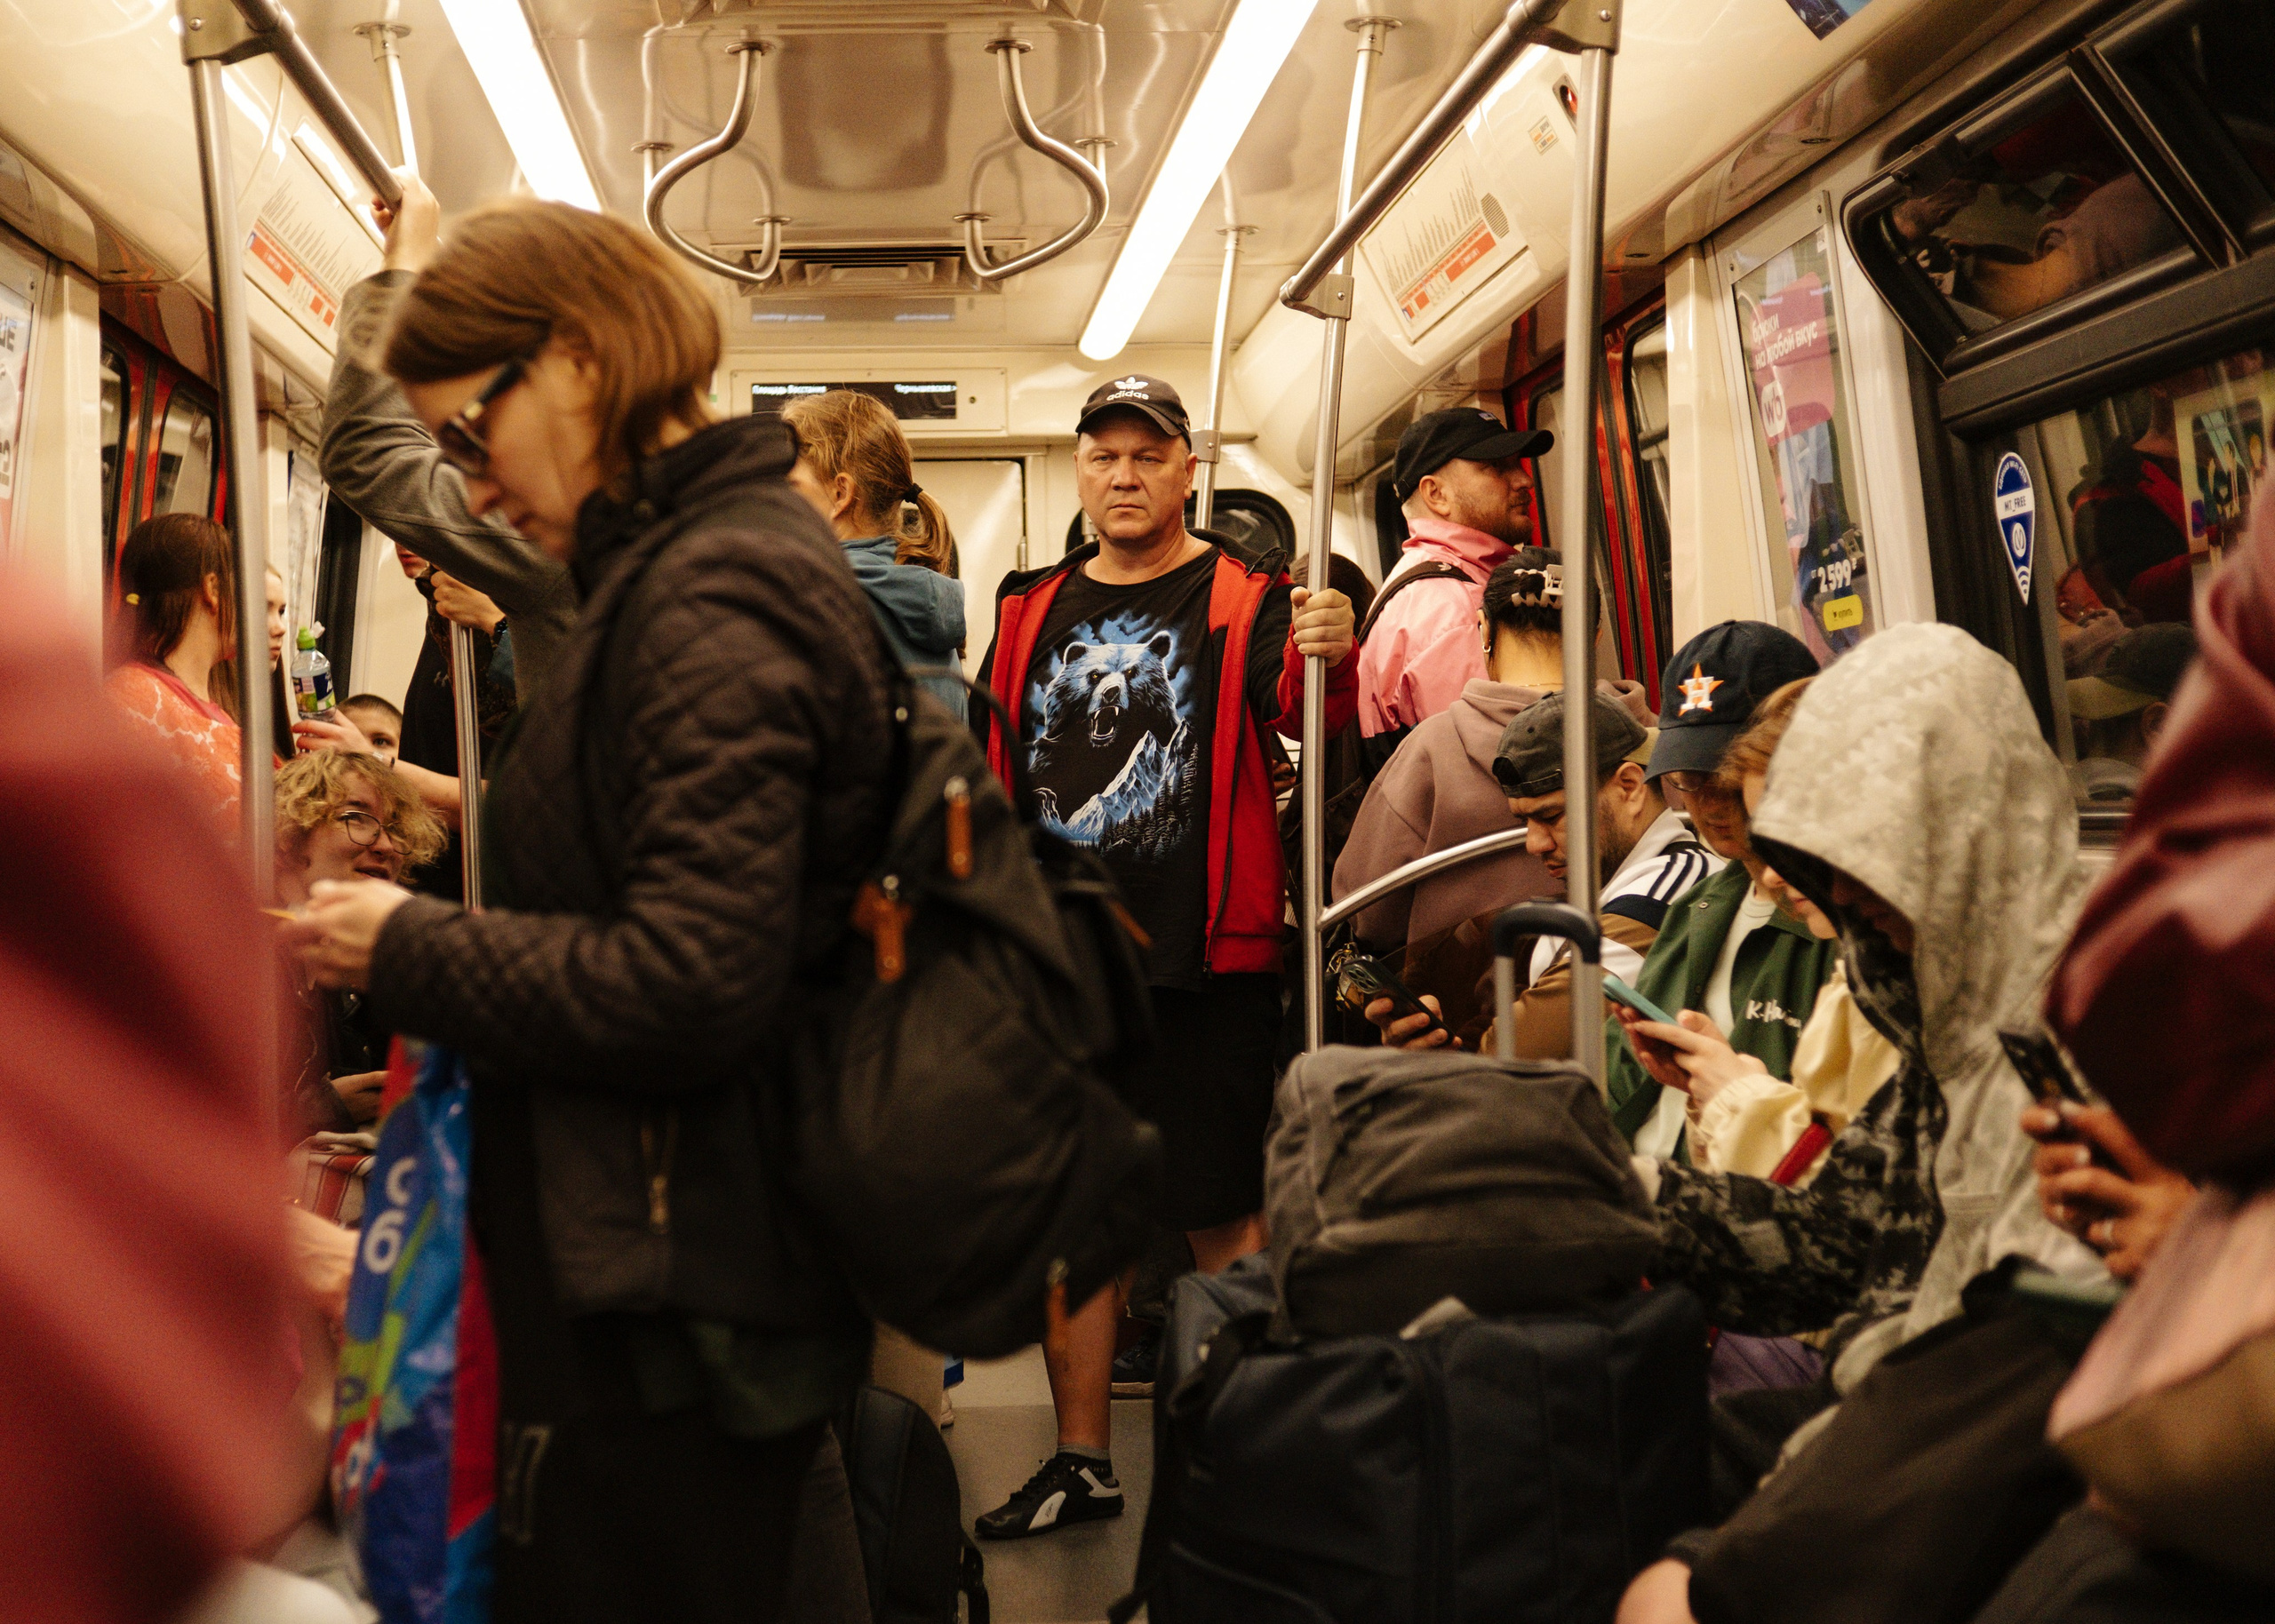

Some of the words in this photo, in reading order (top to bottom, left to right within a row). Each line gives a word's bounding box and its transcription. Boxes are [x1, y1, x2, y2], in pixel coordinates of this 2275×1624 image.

[1752, 313, 1780, 346] брюки
[1755, 352, 1767, 370] на
[1767, 328, 1795, 364] любой
[1795, 321, 1818, 347] вкус
[1106, 390, 1150, 401] adidas
[2005, 496, 2026, 512] MT_FREE
[1680, 676, 1714, 709] H
